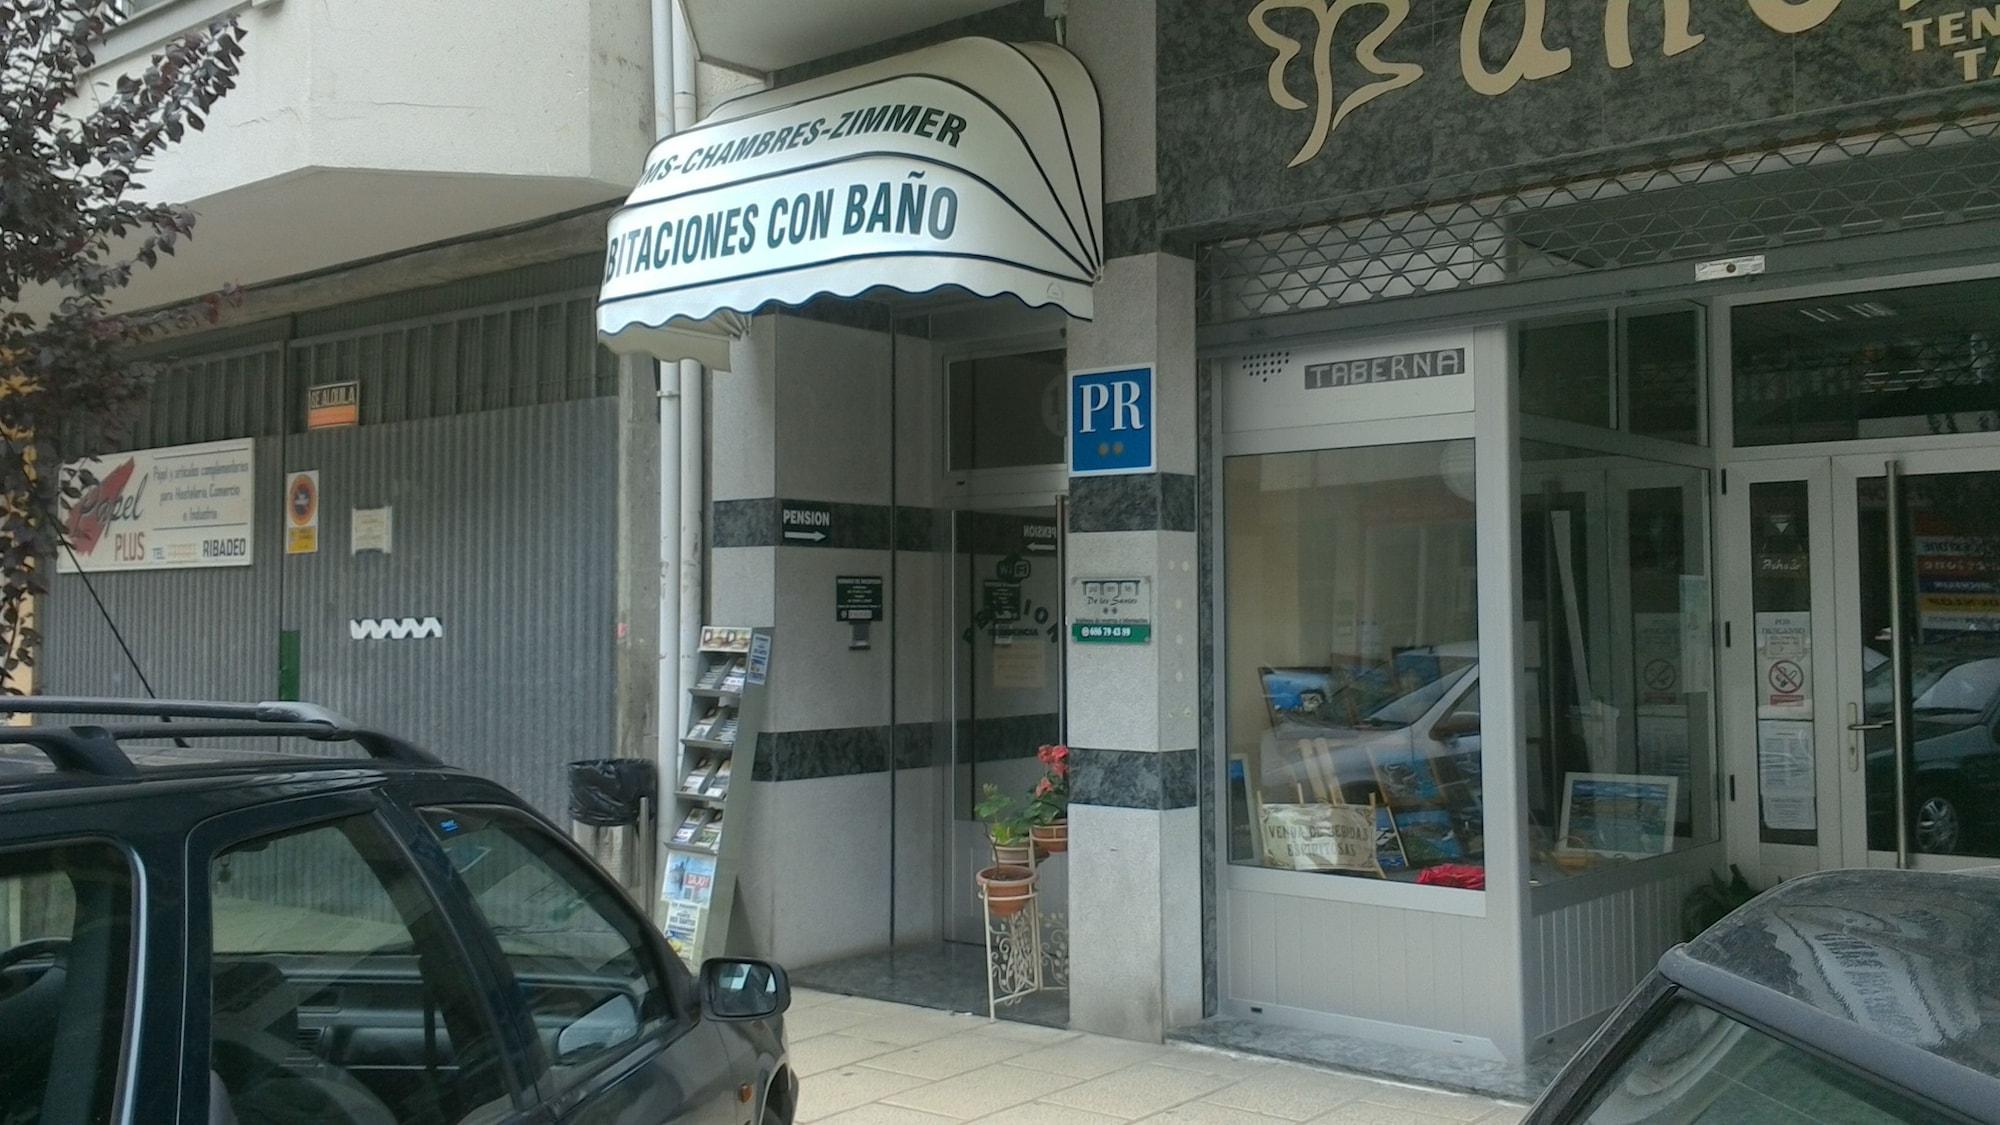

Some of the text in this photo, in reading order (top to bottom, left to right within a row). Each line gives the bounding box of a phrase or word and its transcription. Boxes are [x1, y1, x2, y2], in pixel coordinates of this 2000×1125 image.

[1953, 47, 2000, 81] T
[638, 104, 967, 186] MS-CHAMBRES-ZIMMER
[603, 170, 958, 284] BITACIONES CON BAÑO
[1310, 350, 1459, 387] TABERNA
[1080, 380, 1144, 433] PR
[783, 509, 830, 526] PENSION
[114, 531, 145, 561] PLUS
[203, 538, 246, 558] RIBADEO
